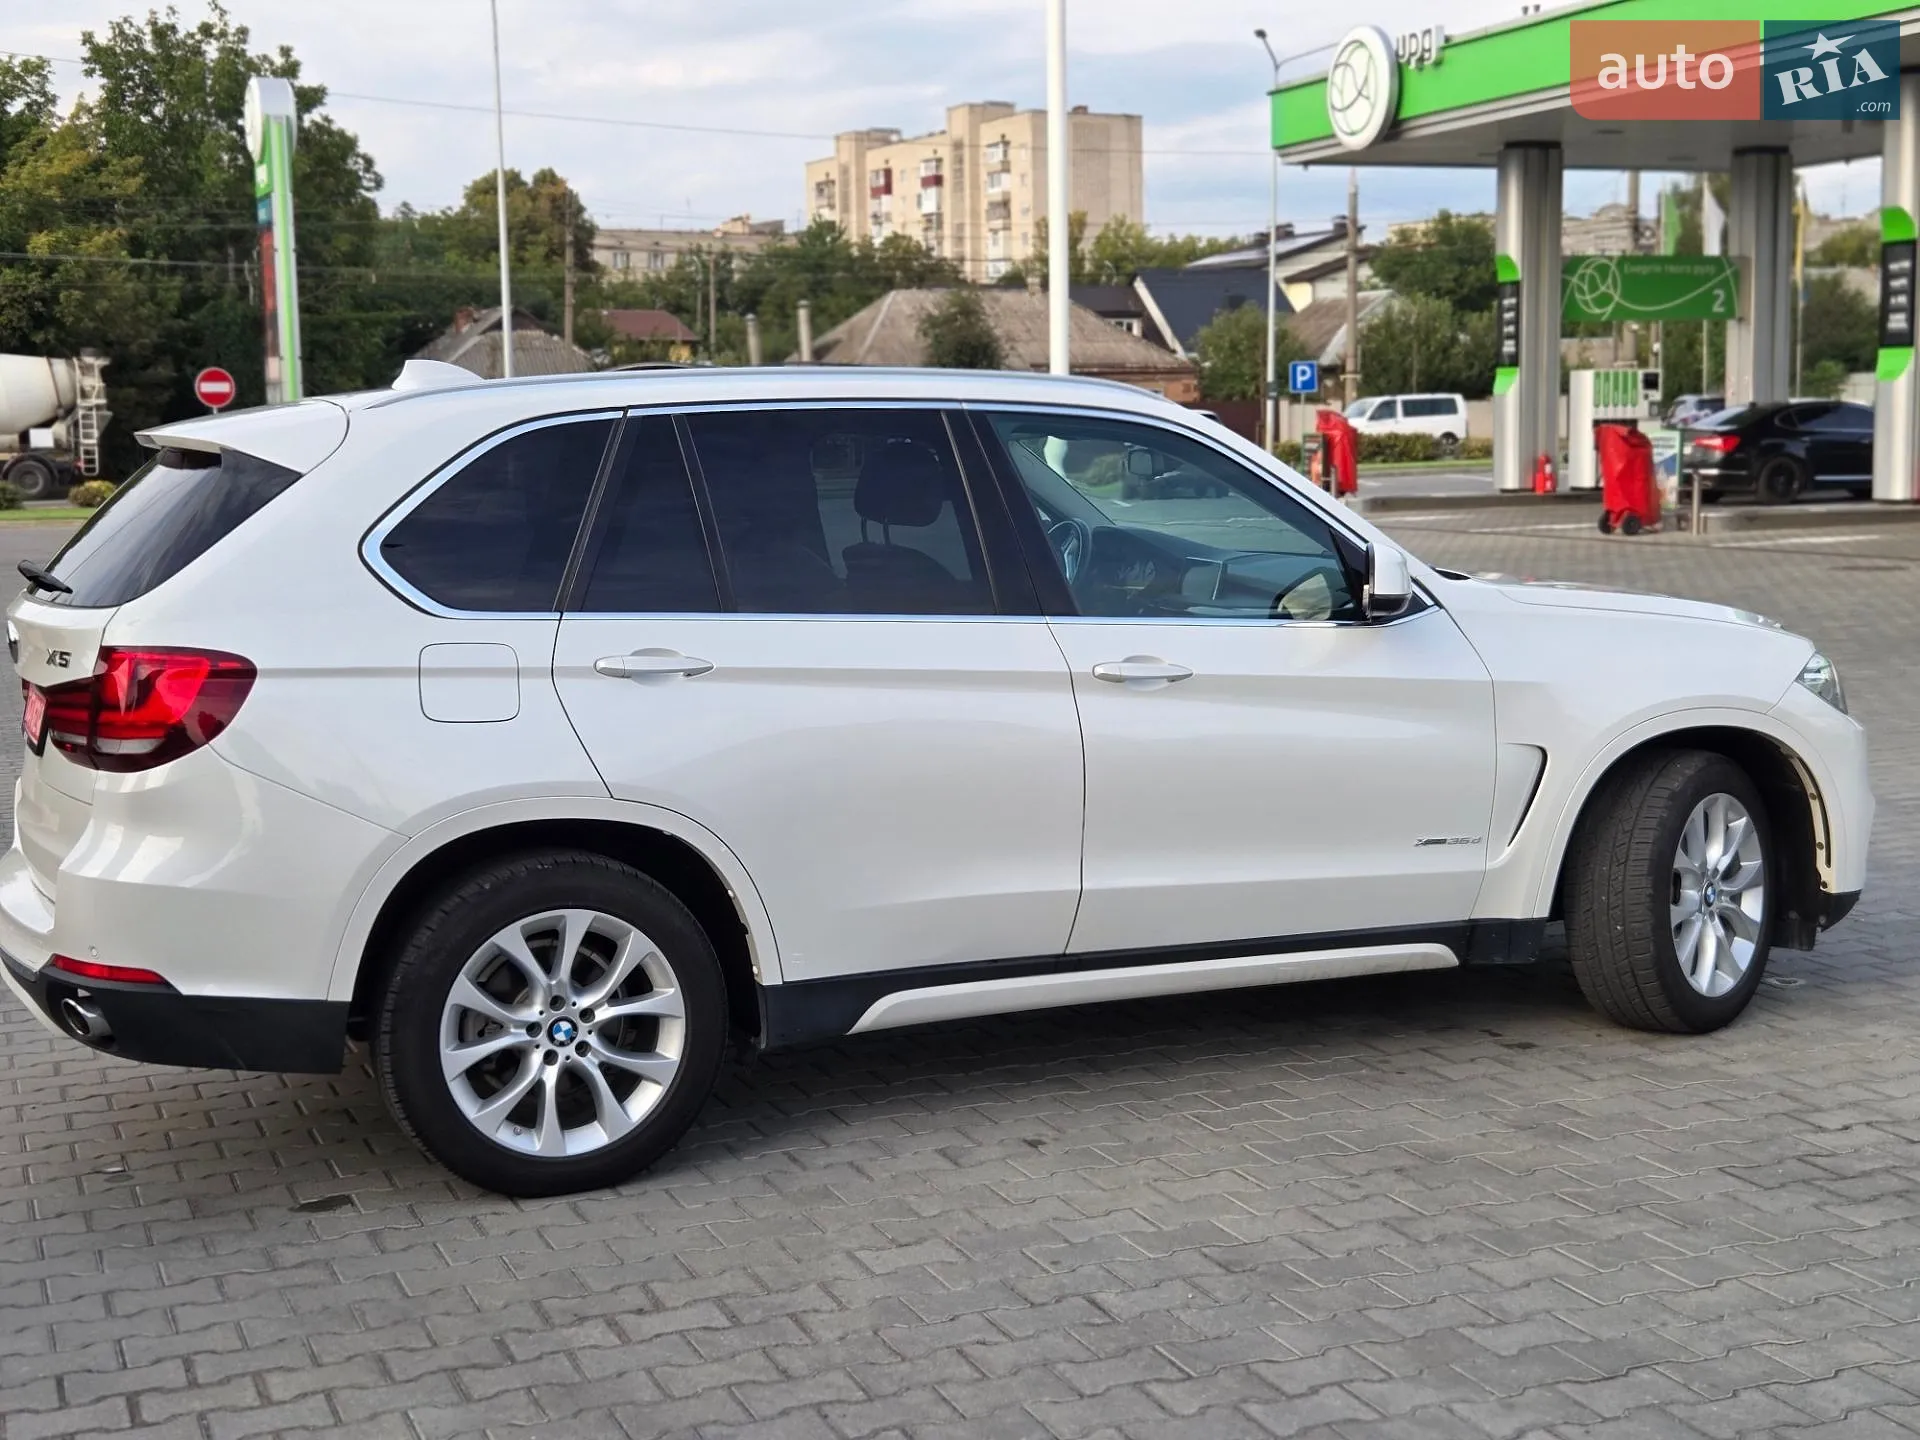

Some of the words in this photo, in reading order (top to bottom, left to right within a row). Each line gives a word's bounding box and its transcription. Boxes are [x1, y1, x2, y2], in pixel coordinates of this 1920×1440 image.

[1711, 288, 1726, 313] 2
[1296, 365, 1312, 389] P
[46, 648, 72, 669] X5
